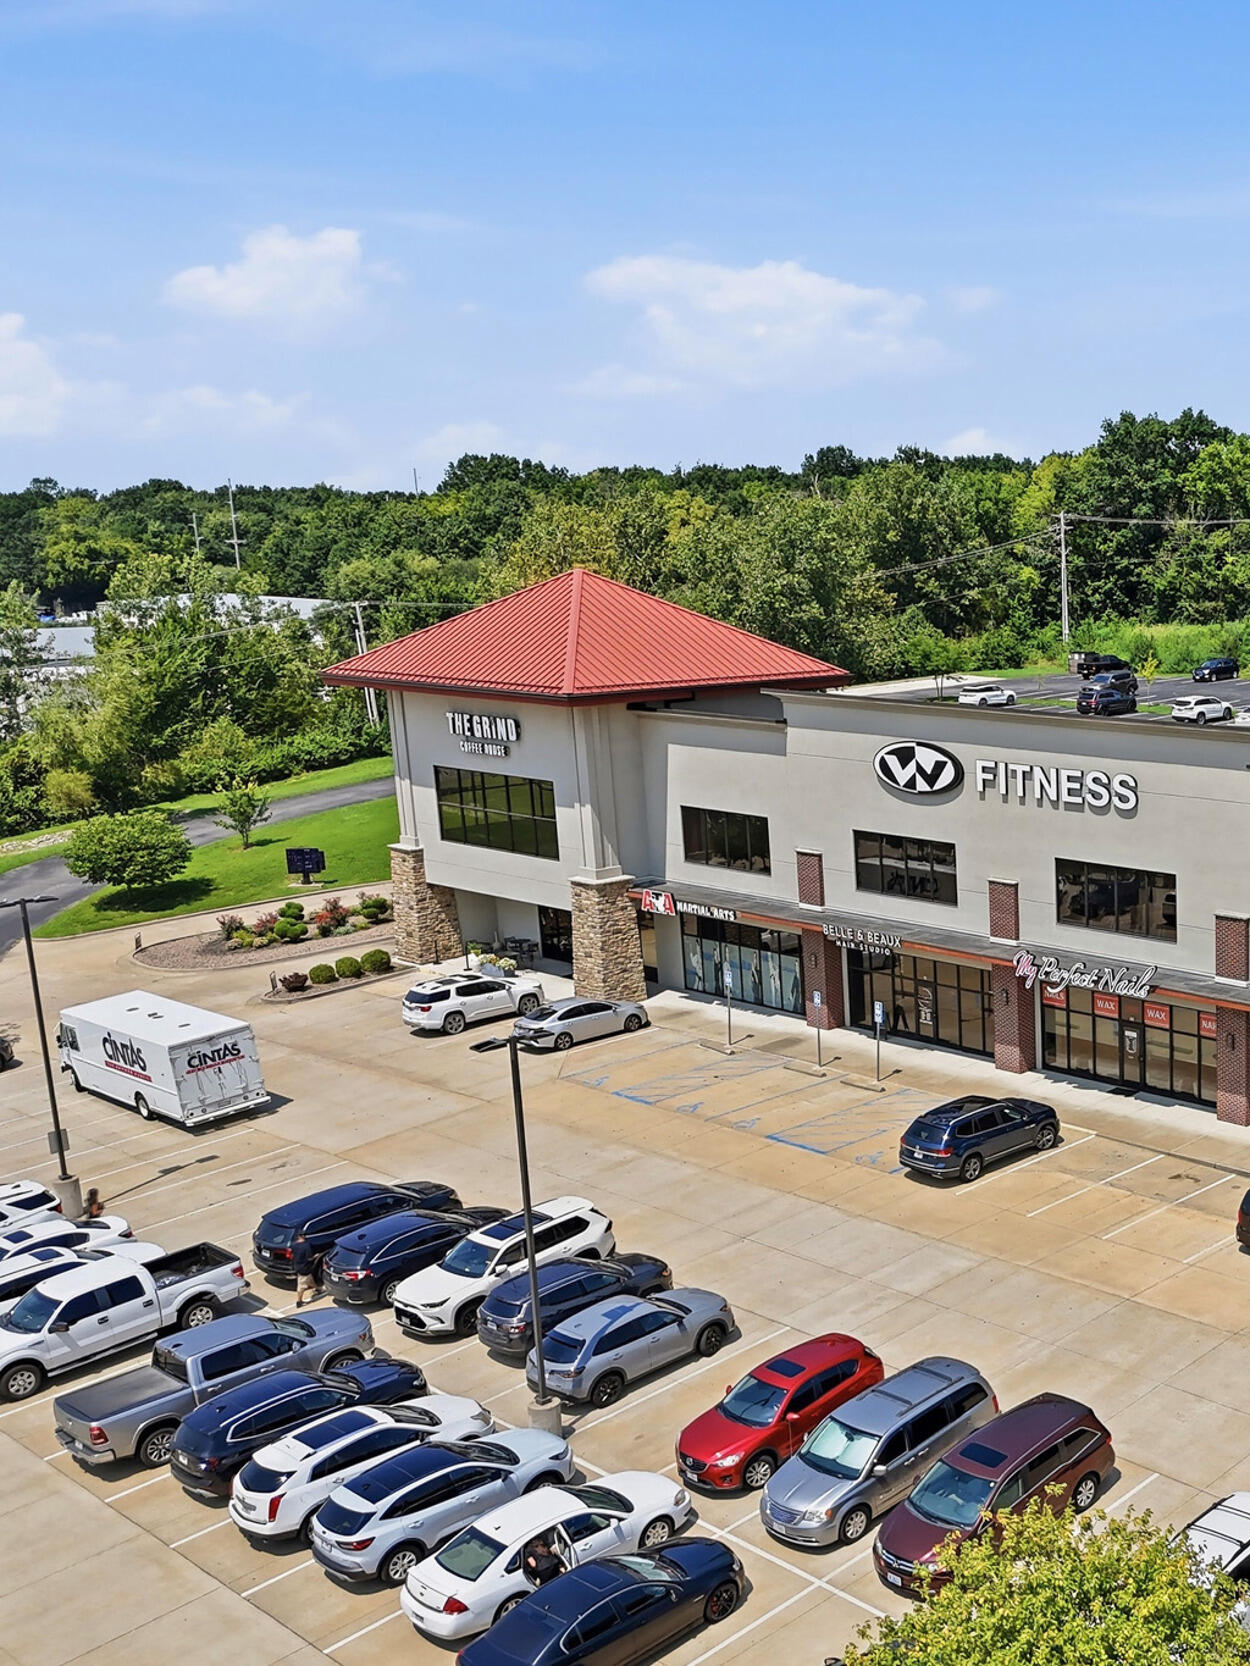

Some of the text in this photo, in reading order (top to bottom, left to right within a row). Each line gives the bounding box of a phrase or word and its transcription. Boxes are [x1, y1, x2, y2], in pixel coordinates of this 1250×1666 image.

[445, 712, 471, 737] THE
[459, 740, 506, 757] COFFEE HOUSE
[975, 758, 1139, 811] FITNESS
[676, 901, 711, 917] MARTIAL
[713, 907, 735, 921] ARTS
[822, 923, 902, 948] BELLE & BEAUX
[859, 943, 891, 956] STUDIO
[1013, 950, 1157, 998] My Perfect Nails
[1096, 999, 1116, 1011] WAX
[1146, 1008, 1166, 1020] WAX
